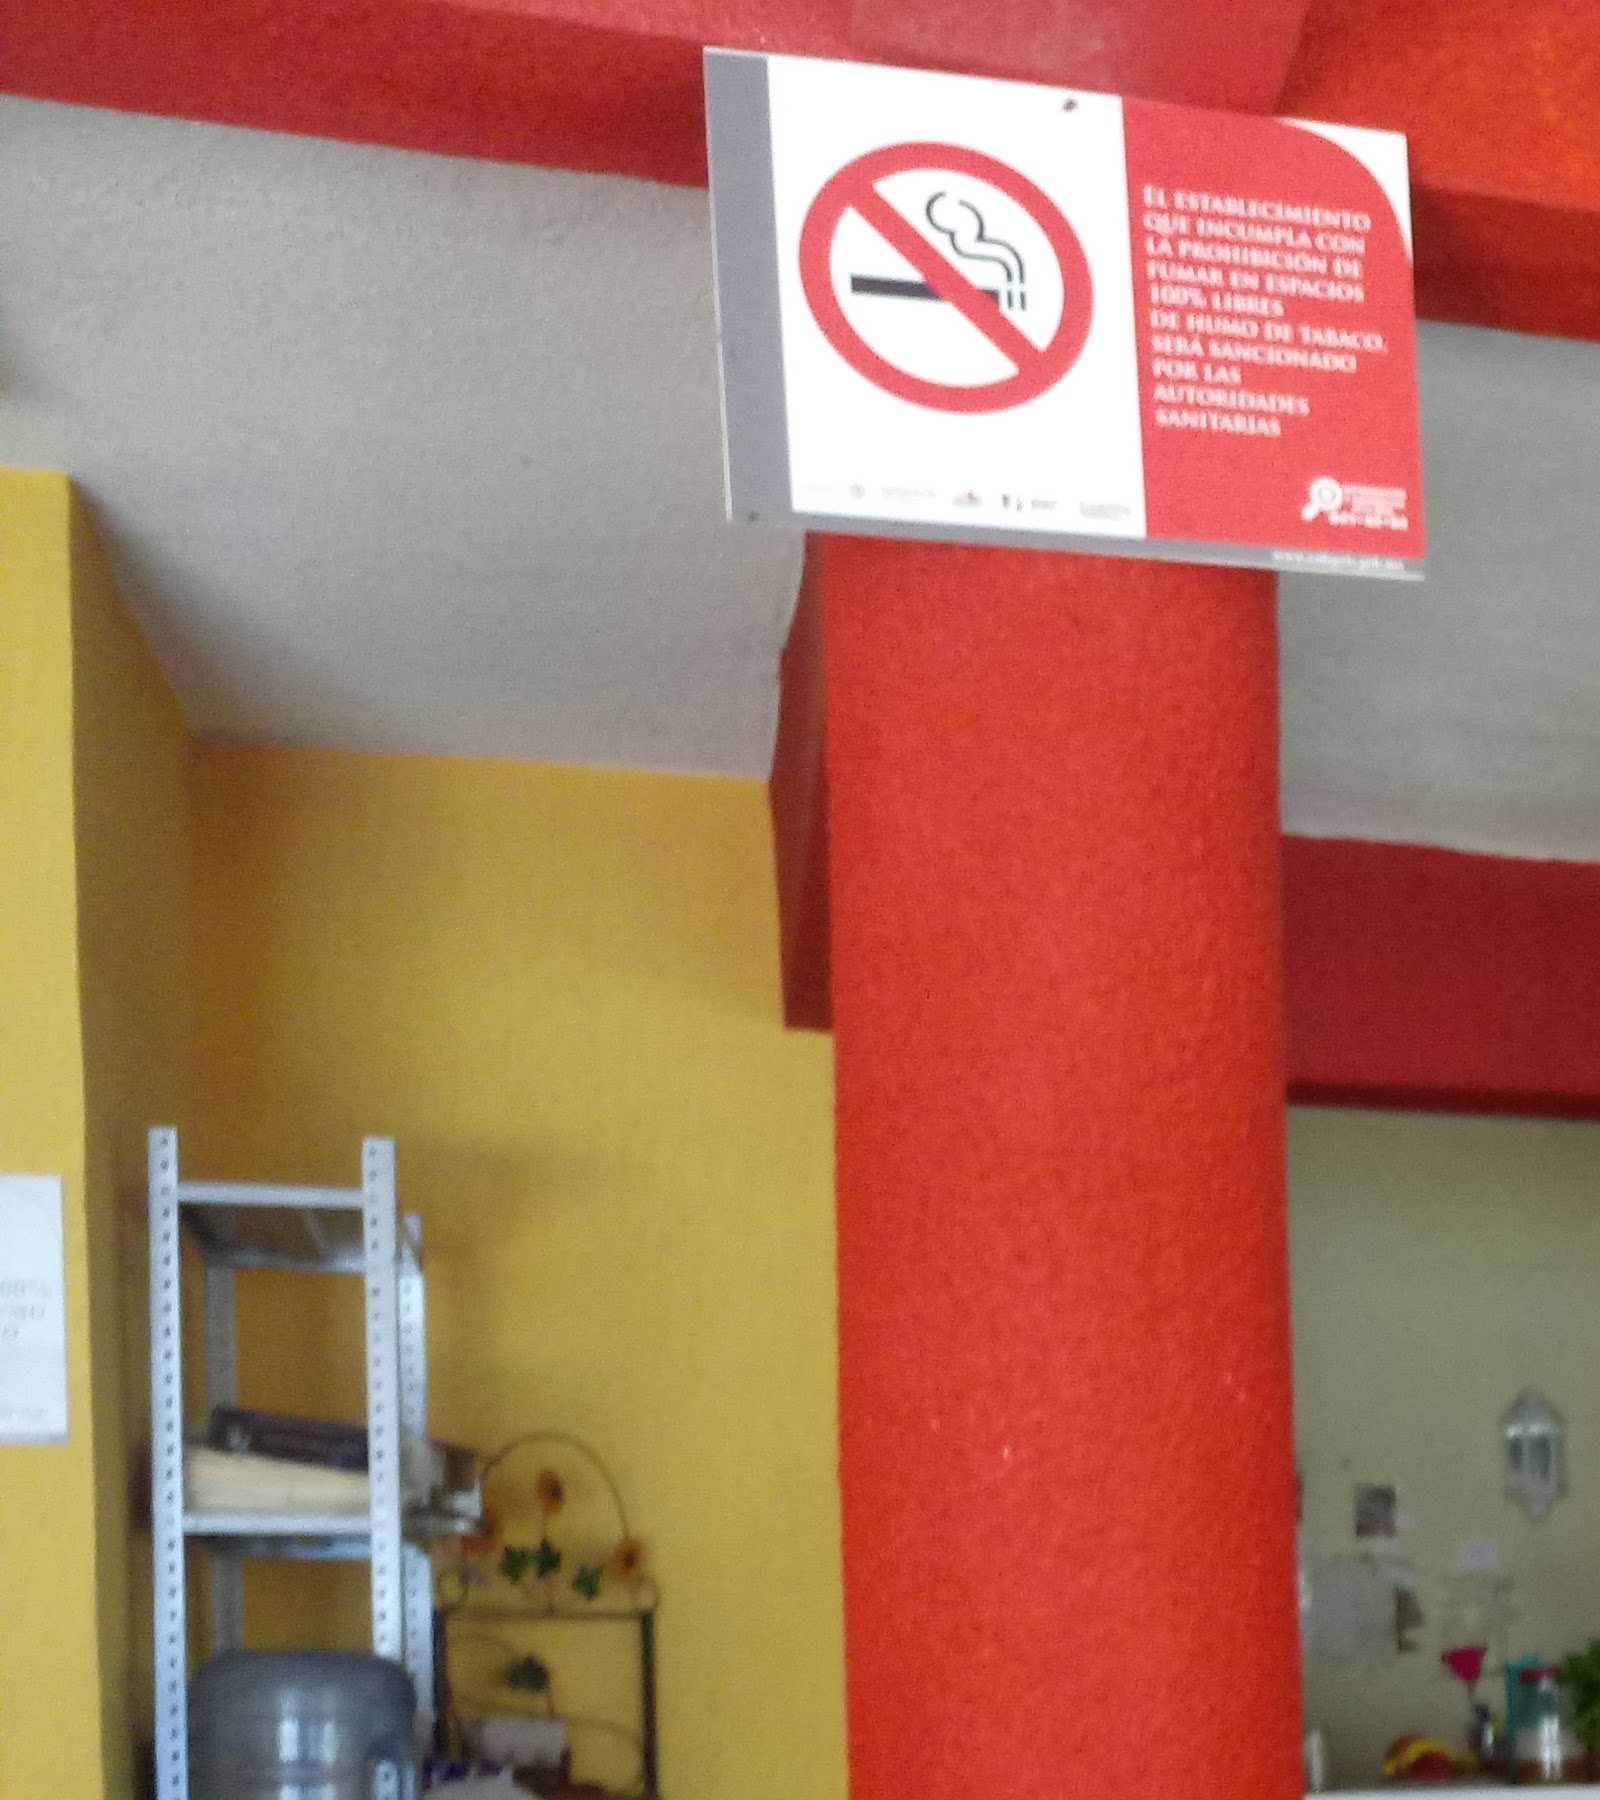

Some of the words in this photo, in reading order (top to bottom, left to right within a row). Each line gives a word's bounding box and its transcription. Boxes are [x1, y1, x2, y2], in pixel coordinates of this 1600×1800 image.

[1143, 184, 1166, 208] EL
[1174, 190, 1371, 232] ESTABLECIMIENTO
[1143, 212, 1189, 235] QUE
[1196, 216, 1313, 249] INCUMPLA
[1315, 232, 1365, 254] CON
[1146, 235, 1173, 256] LA
[1333, 256, 1362, 279] DE
[1147, 259, 1224, 286] FUMAR
[1229, 270, 1259, 290] EN
[1265, 272, 1364, 303] ESPACIOS
[1151, 282, 1207, 307] 100%
[1211, 290, 1284, 317] LIBRES
[1151, 309, 1179, 331] DE
[1186, 313, 1259, 339] HUMO
[1263, 321, 1294, 343] DE
[1152, 355, 1198, 381] POR
[1203, 363, 1242, 385] LAS
[1208, 339, 1357, 373] SANCIONADO
[1153, 383, 1311, 416] AUTORIDADES
[1154, 407, 1281, 437] SANITARIAS
